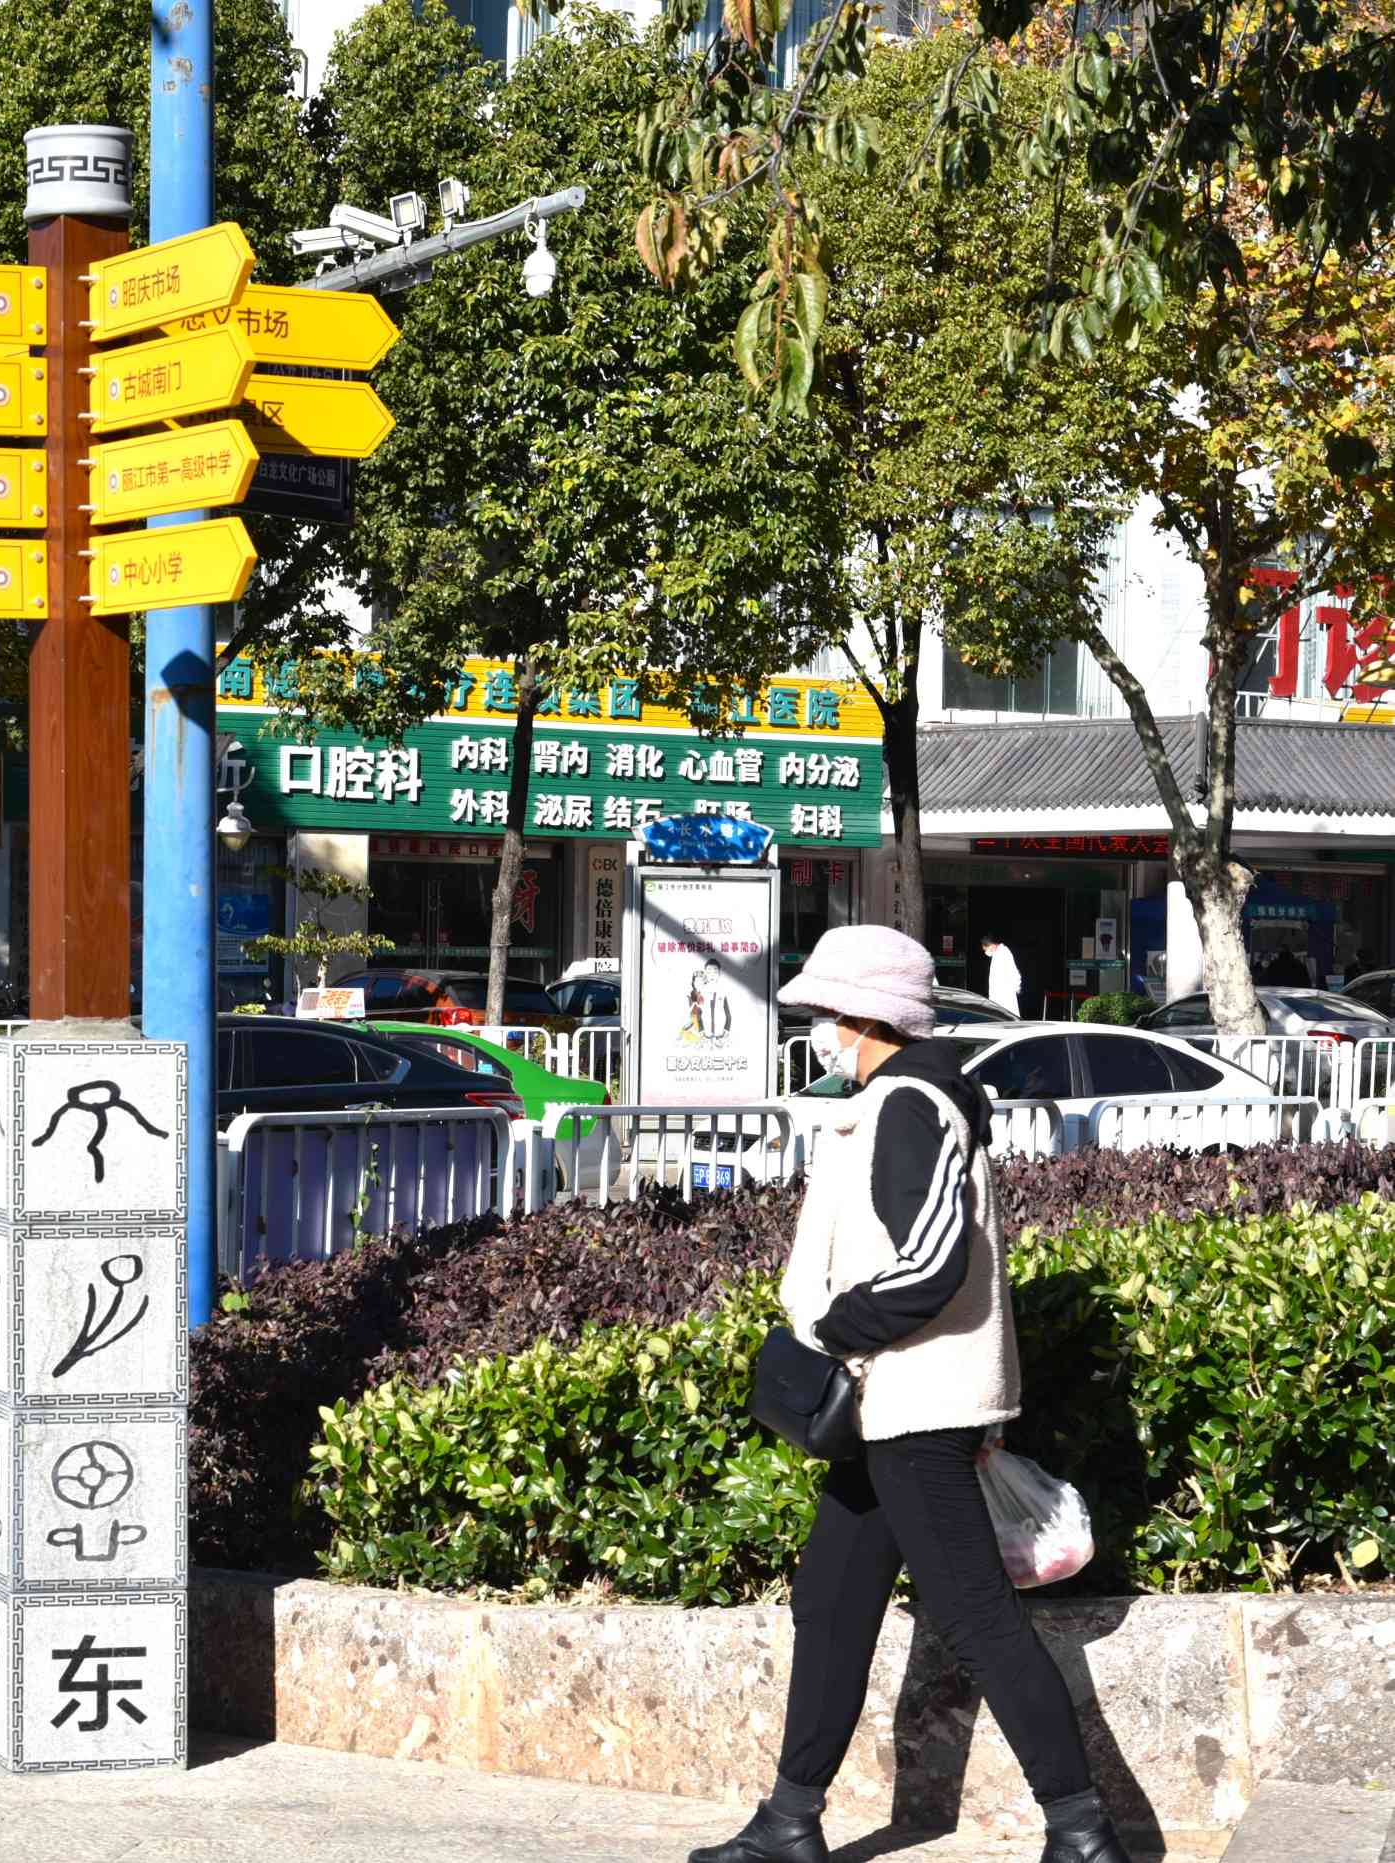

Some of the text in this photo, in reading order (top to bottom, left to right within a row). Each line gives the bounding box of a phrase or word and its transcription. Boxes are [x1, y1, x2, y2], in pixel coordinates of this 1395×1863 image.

[122, 265, 181, 306] 昭庆市场
[122, 360, 182, 404] 古城南门
[121, 450, 231, 492] 丽江市第一高级中学
[124, 551, 183, 586] 中心小学
[279, 745, 422, 802] 口腔科
[451, 735, 860, 787] 内科 肾内 消化 心血管 内分泌
[450, 789, 508, 824] 外科
[534, 794, 593, 828] 泌尿
[604, 796, 662, 829] 结石
[791, 804, 843, 838] 妇科
[50, 1634, 147, 1732] 东
